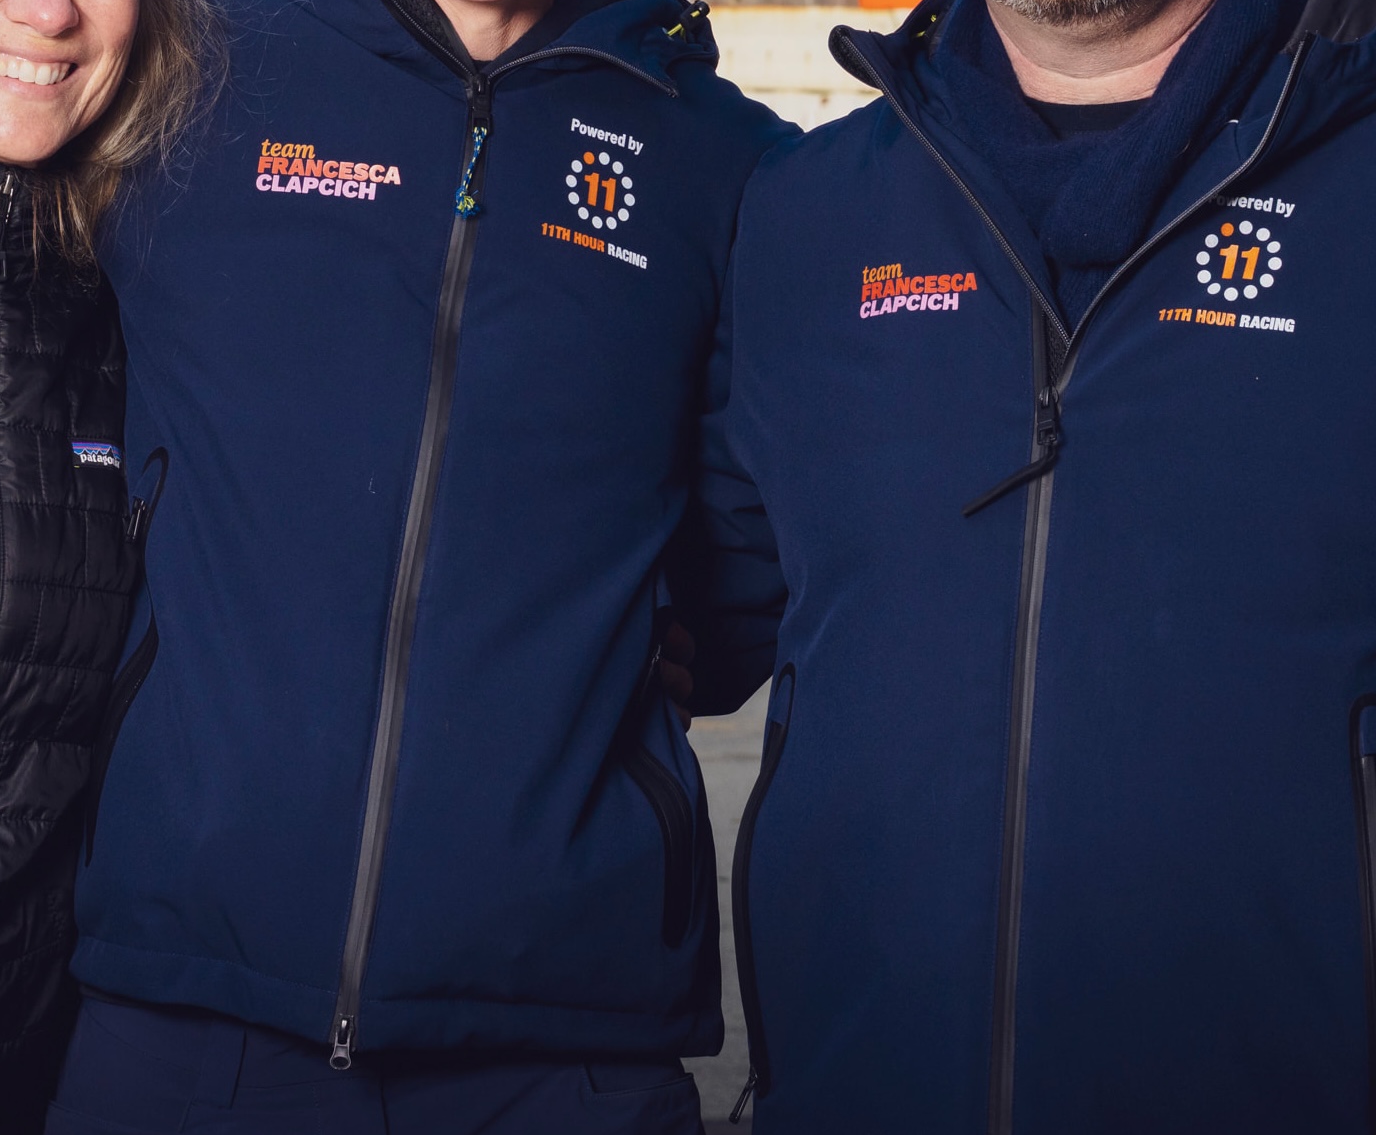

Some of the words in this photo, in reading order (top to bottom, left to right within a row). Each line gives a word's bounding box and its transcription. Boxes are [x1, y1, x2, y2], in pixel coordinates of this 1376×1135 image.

[261, 138, 316, 159] team
[570, 118, 627, 147] Powered
[627, 135, 644, 156] by
[257, 156, 401, 185] FRANCESCA
[255, 173, 377, 200] CLAPCICH
[584, 172, 617, 212] 11
[1275, 198, 1296, 218] by
[541, 222, 571, 242] 11TH
[573, 231, 605, 253] HOUR
[607, 243, 648, 269] RACING
[862, 263, 903, 284] team
[1219, 244, 1260, 280] 11
[861, 272, 977, 302] FRANCESCA
[859, 293, 959, 319] CLAPCICH
[1158, 308, 1192, 322] 11TH
[1195, 309, 1236, 327] HOUR
[1239, 314, 1296, 333] RACING
